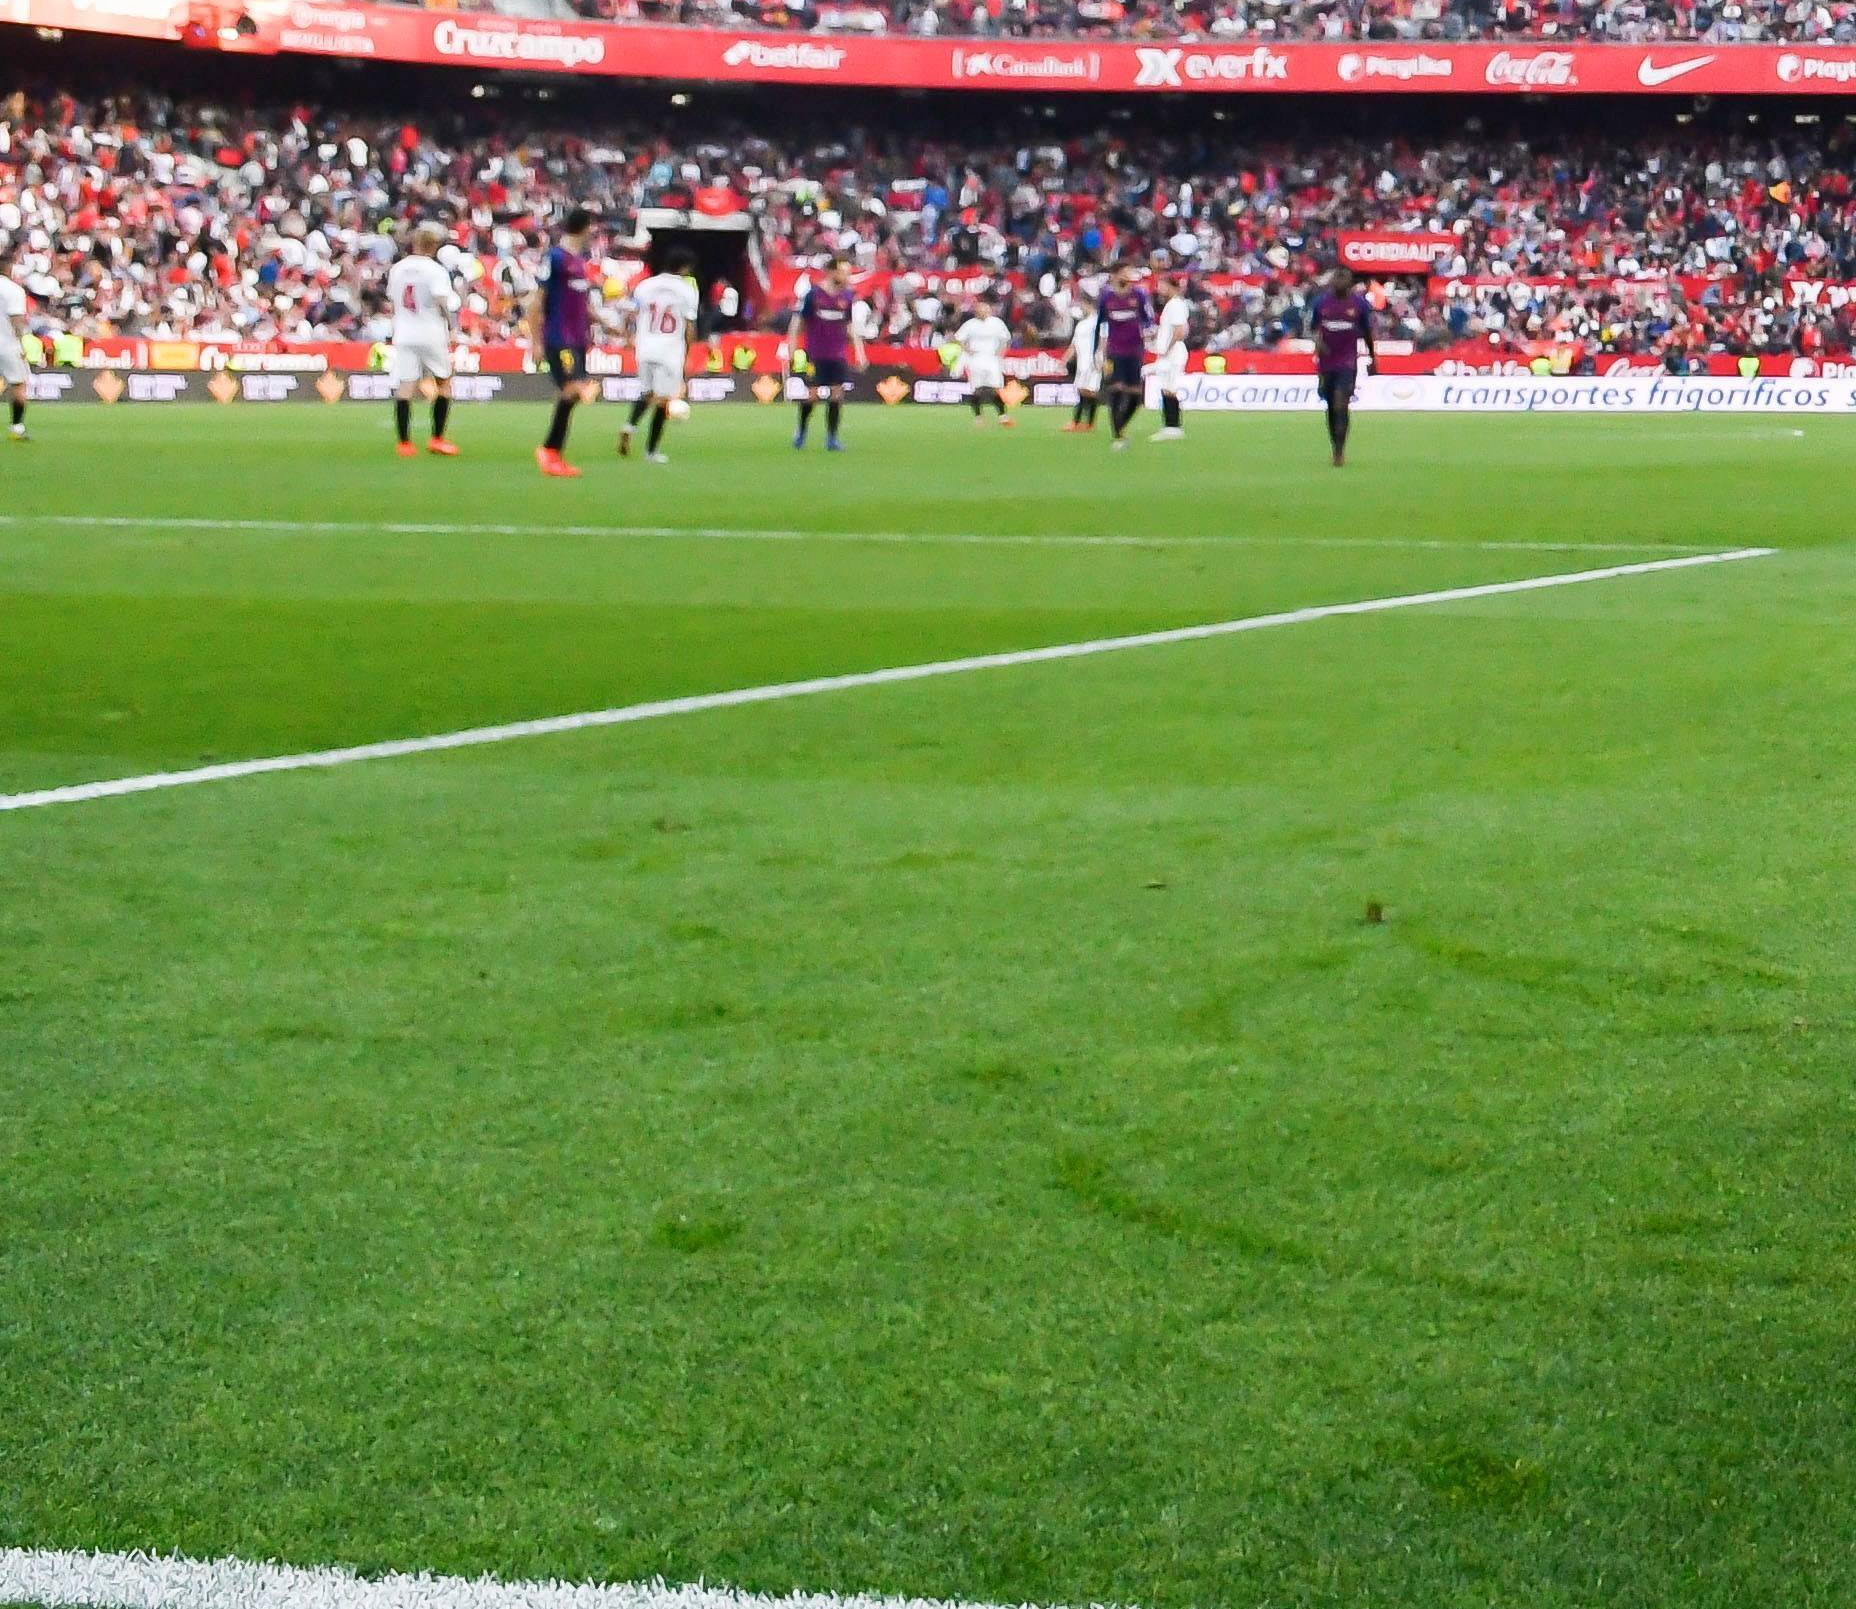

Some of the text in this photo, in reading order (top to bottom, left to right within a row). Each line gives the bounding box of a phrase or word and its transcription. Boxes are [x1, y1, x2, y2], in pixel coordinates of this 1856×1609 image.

[433, 19, 605, 69] Cruzcampo
[748, 40, 847, 69] betfair
[1185, 46, 1288, 80] everfx
[1176, 378, 1359, 404] olocanar
[1443, 385, 1636, 412] transportes
